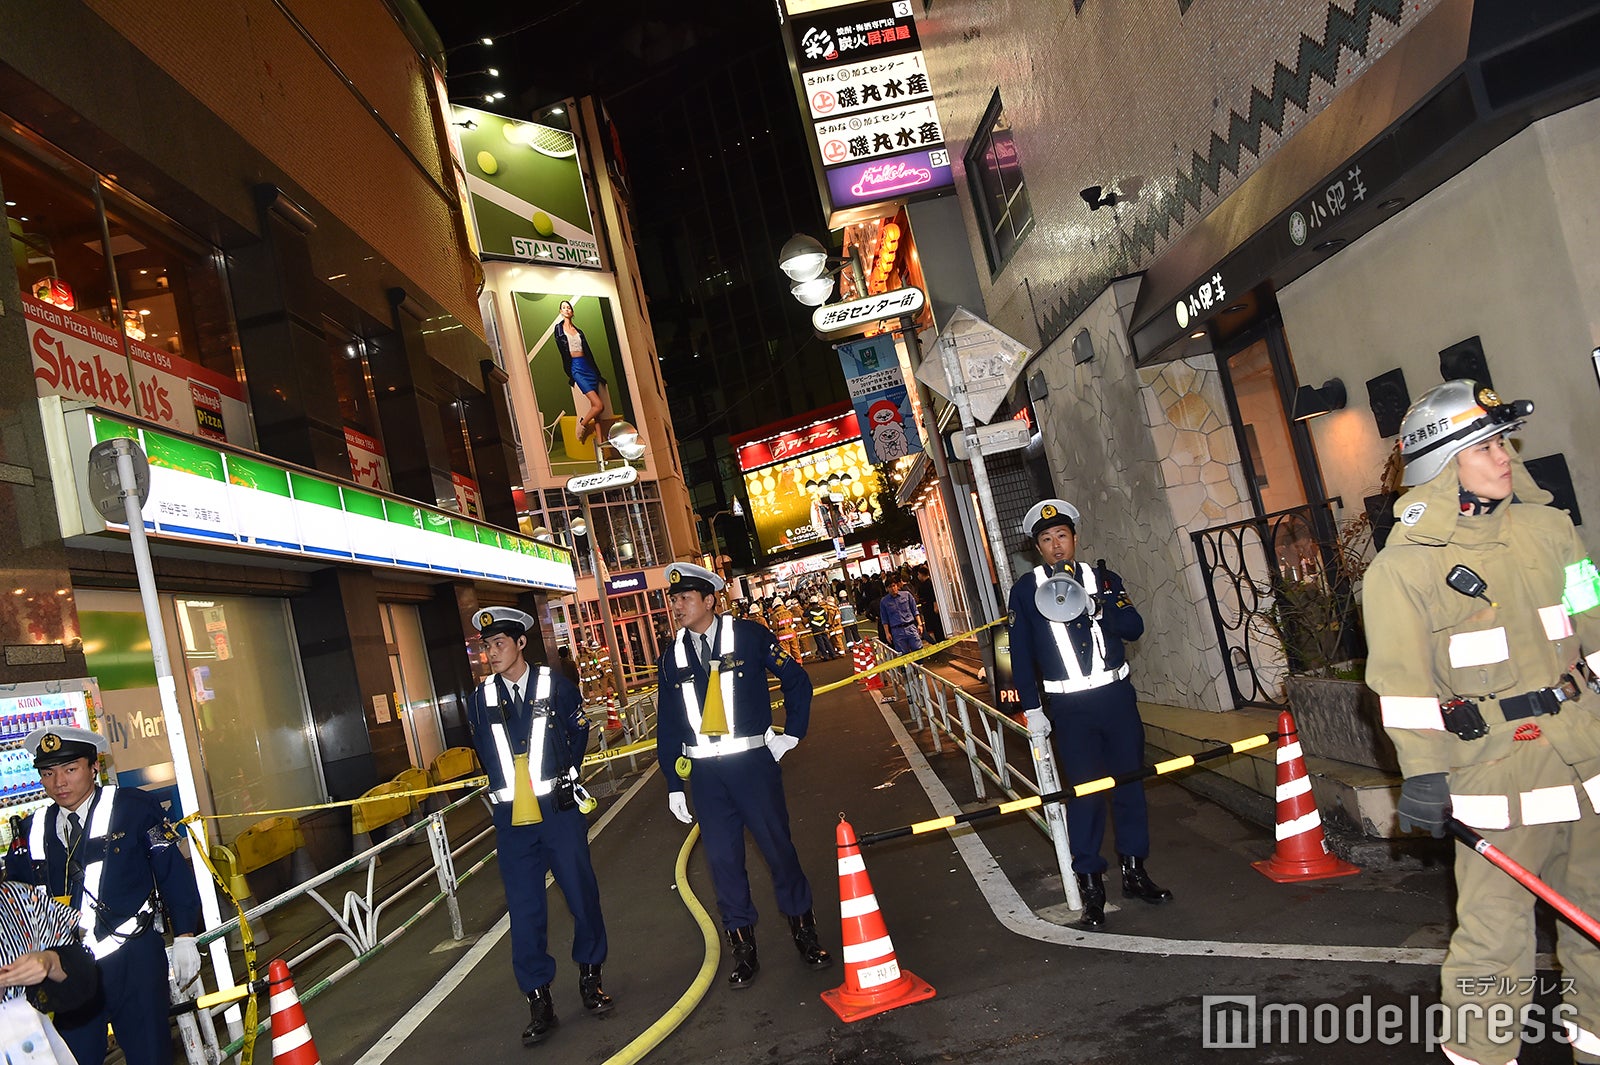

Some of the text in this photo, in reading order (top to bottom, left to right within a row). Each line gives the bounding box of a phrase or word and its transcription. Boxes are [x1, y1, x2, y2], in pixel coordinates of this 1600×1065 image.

[899, 2, 909, 15] 3
[801, 26, 836, 59] 彩
[838, 25, 911, 51] 炭火居酒屋
[912, 56, 920, 68] 1
[836, 73, 930, 108] 磯丸水産
[924, 105, 932, 118] 1
[848, 122, 941, 157] 磯丸水産
[930, 151, 949, 166] B1
[515, 239, 600, 265] STAN SMITH
[569, 239, 595, 249] DISCOVER
[822, 292, 916, 325] 渋谷センター街
[63, 314, 88, 336] Pizza
[90, 325, 118, 348] House
[129, 343, 152, 361] since
[152, 351, 172, 370] 1954
[18, 697, 43, 709] KIRIN
